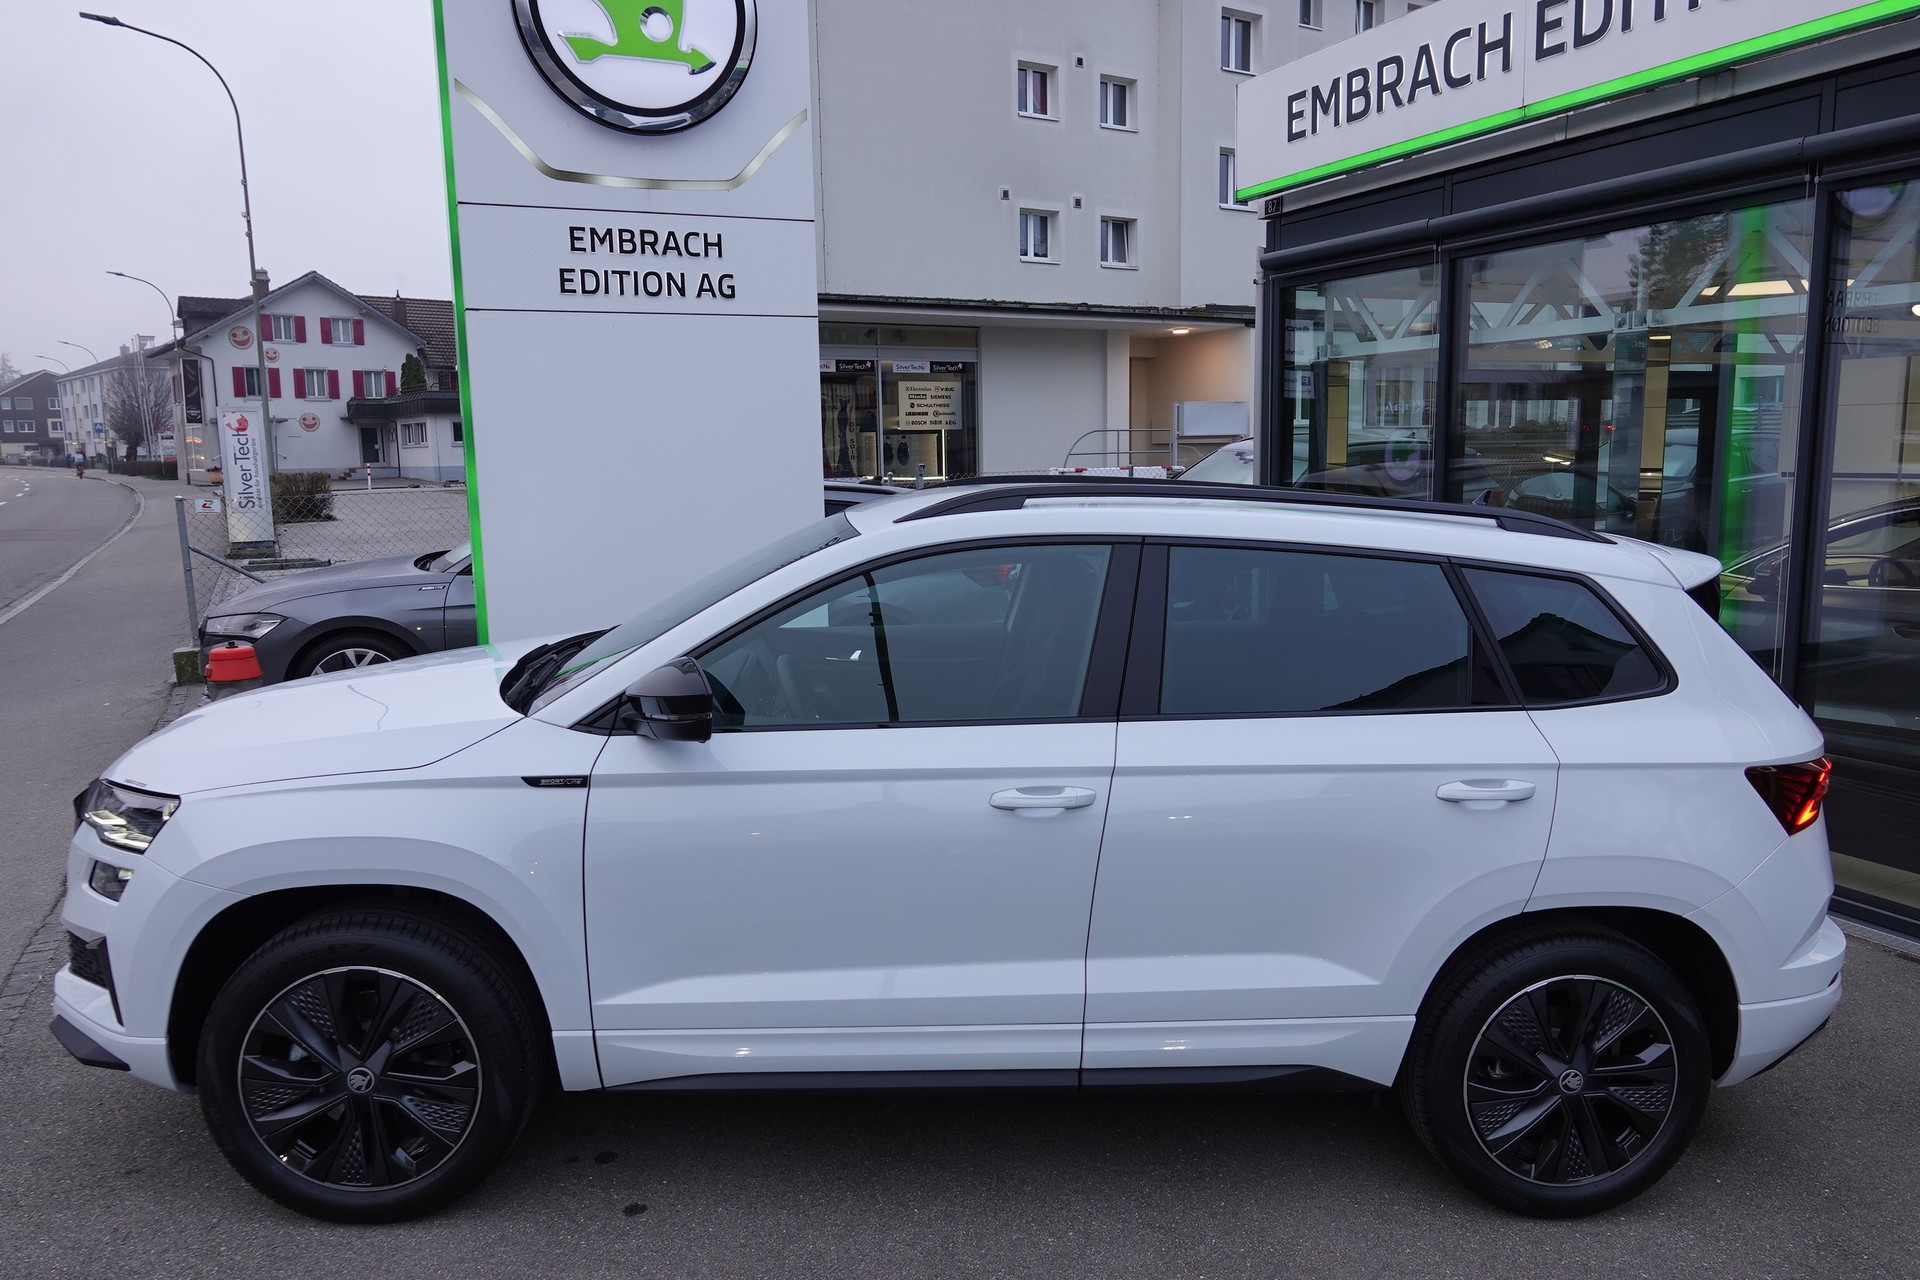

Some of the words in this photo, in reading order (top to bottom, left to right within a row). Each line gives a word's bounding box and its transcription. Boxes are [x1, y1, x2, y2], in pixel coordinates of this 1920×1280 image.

[1285, 11, 1514, 143] EMBRACH
[1268, 199, 1277, 213] 87
[569, 225, 724, 259] EMBRACH
[559, 267, 687, 299] EDITION
[696, 271, 736, 299] AG
